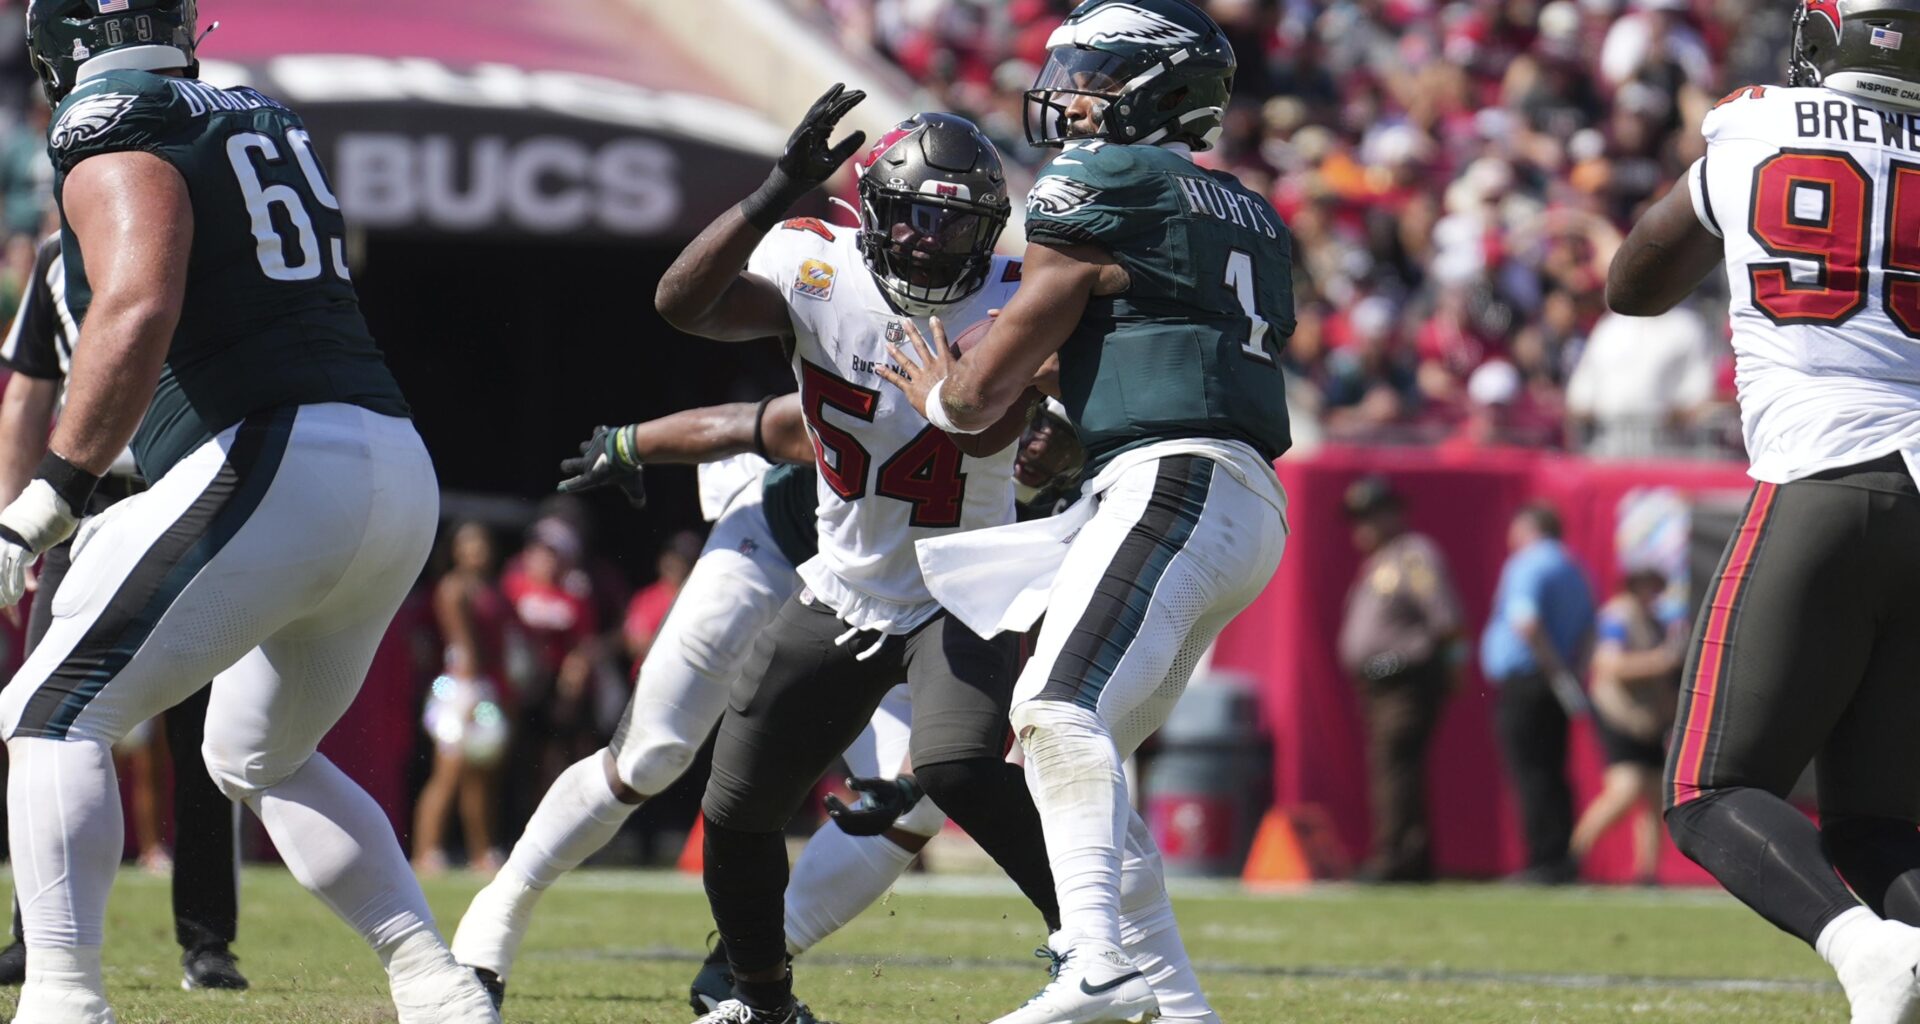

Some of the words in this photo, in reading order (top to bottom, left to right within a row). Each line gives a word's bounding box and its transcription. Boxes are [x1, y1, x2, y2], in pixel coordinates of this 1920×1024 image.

[1856, 79, 1899, 97] INSPIRE
[1900, 89, 1920, 102] CHA
[334, 131, 683, 234] BUCS
[1175, 176, 1278, 240] HURTS
[1224, 250, 1273, 362] 1
[801, 356, 967, 528] 54
